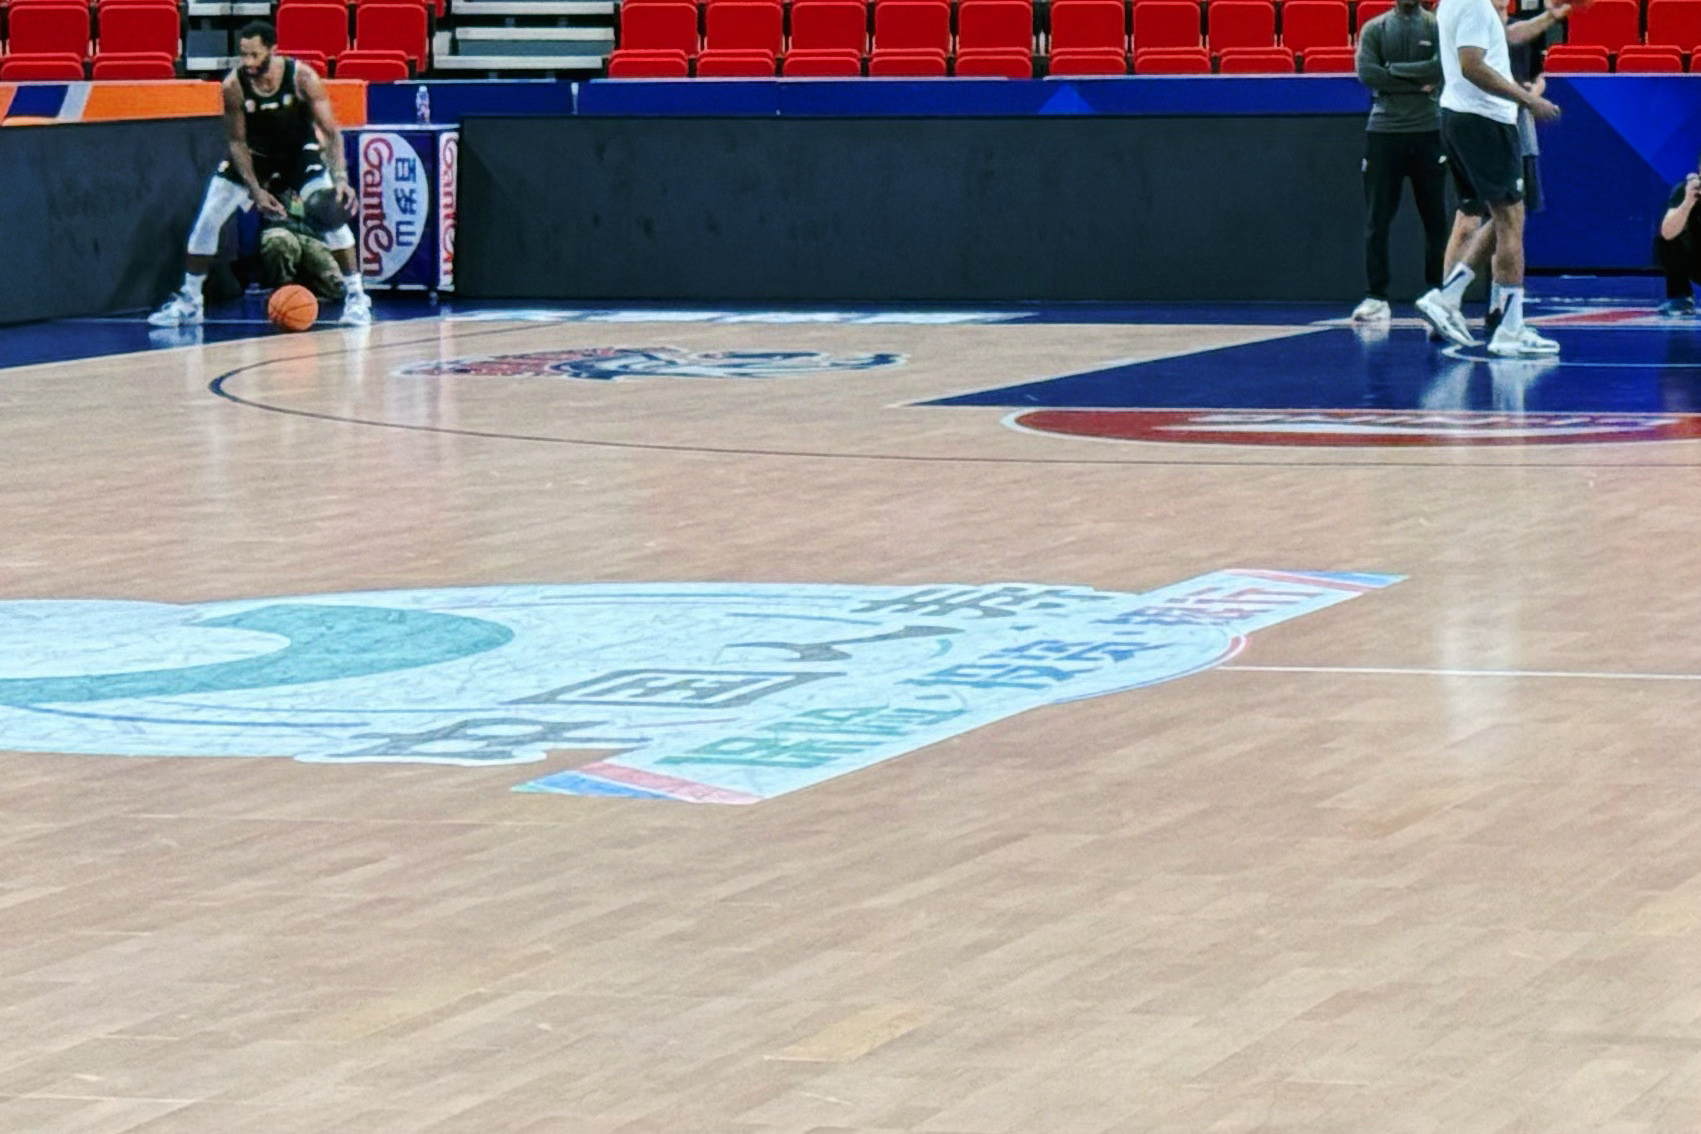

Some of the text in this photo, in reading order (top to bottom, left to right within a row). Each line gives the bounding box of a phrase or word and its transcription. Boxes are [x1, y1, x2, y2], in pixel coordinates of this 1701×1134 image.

[395, 158, 417, 247] 百岁山
[324, 586, 1117, 760] 中国人寿
